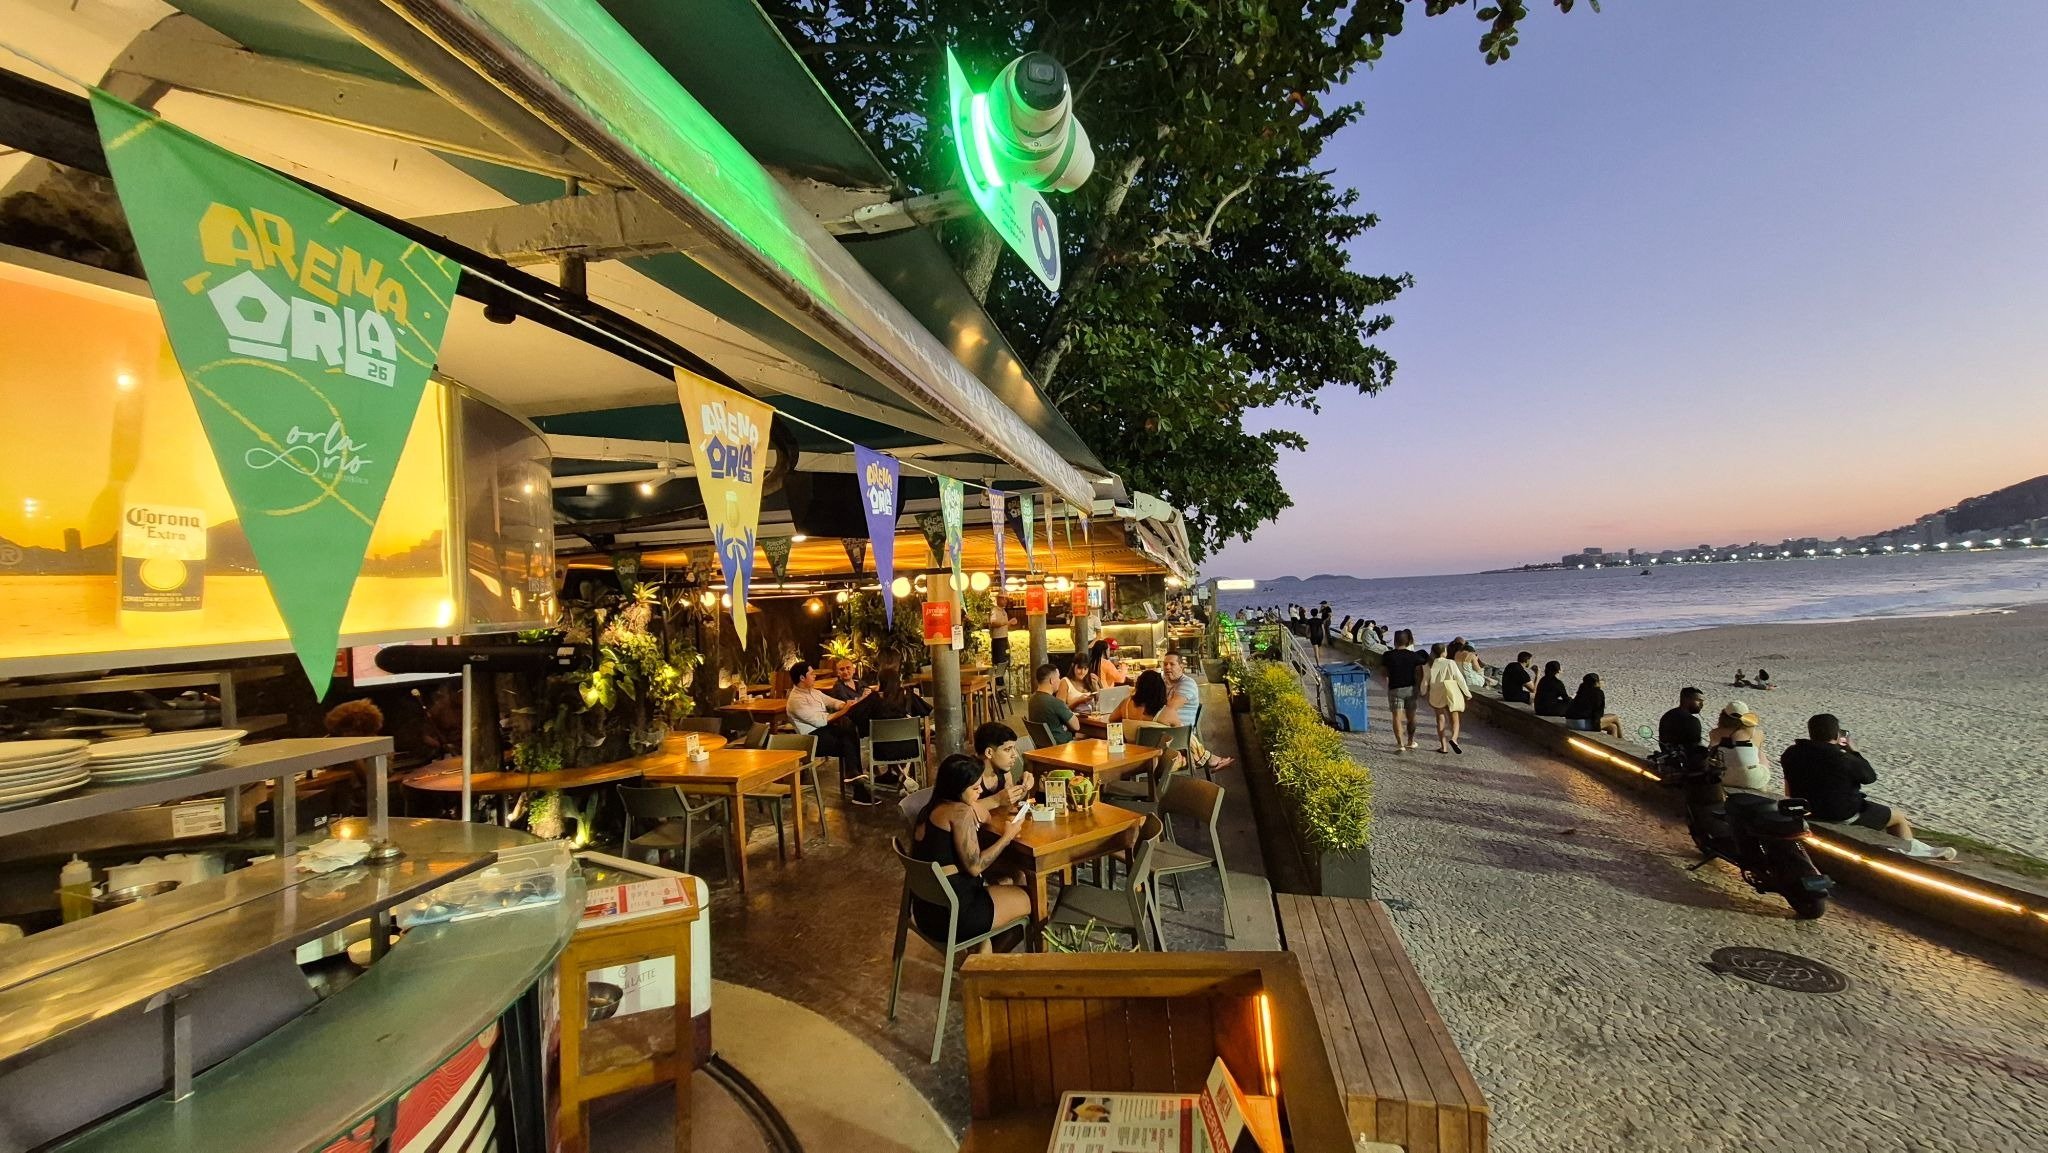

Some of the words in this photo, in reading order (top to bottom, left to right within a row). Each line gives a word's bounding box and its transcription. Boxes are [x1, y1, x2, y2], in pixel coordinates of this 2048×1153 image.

[199, 202, 408, 327] ARENA
[207, 270, 398, 387] ORLA
[367, 361, 388, 381] 26
[286, 420, 368, 455] orla
[701, 401, 759, 450] ARENA
[706, 434, 753, 484] ORLA
[126, 507, 200, 528] Corona
[147, 526, 186, 541] Extra
